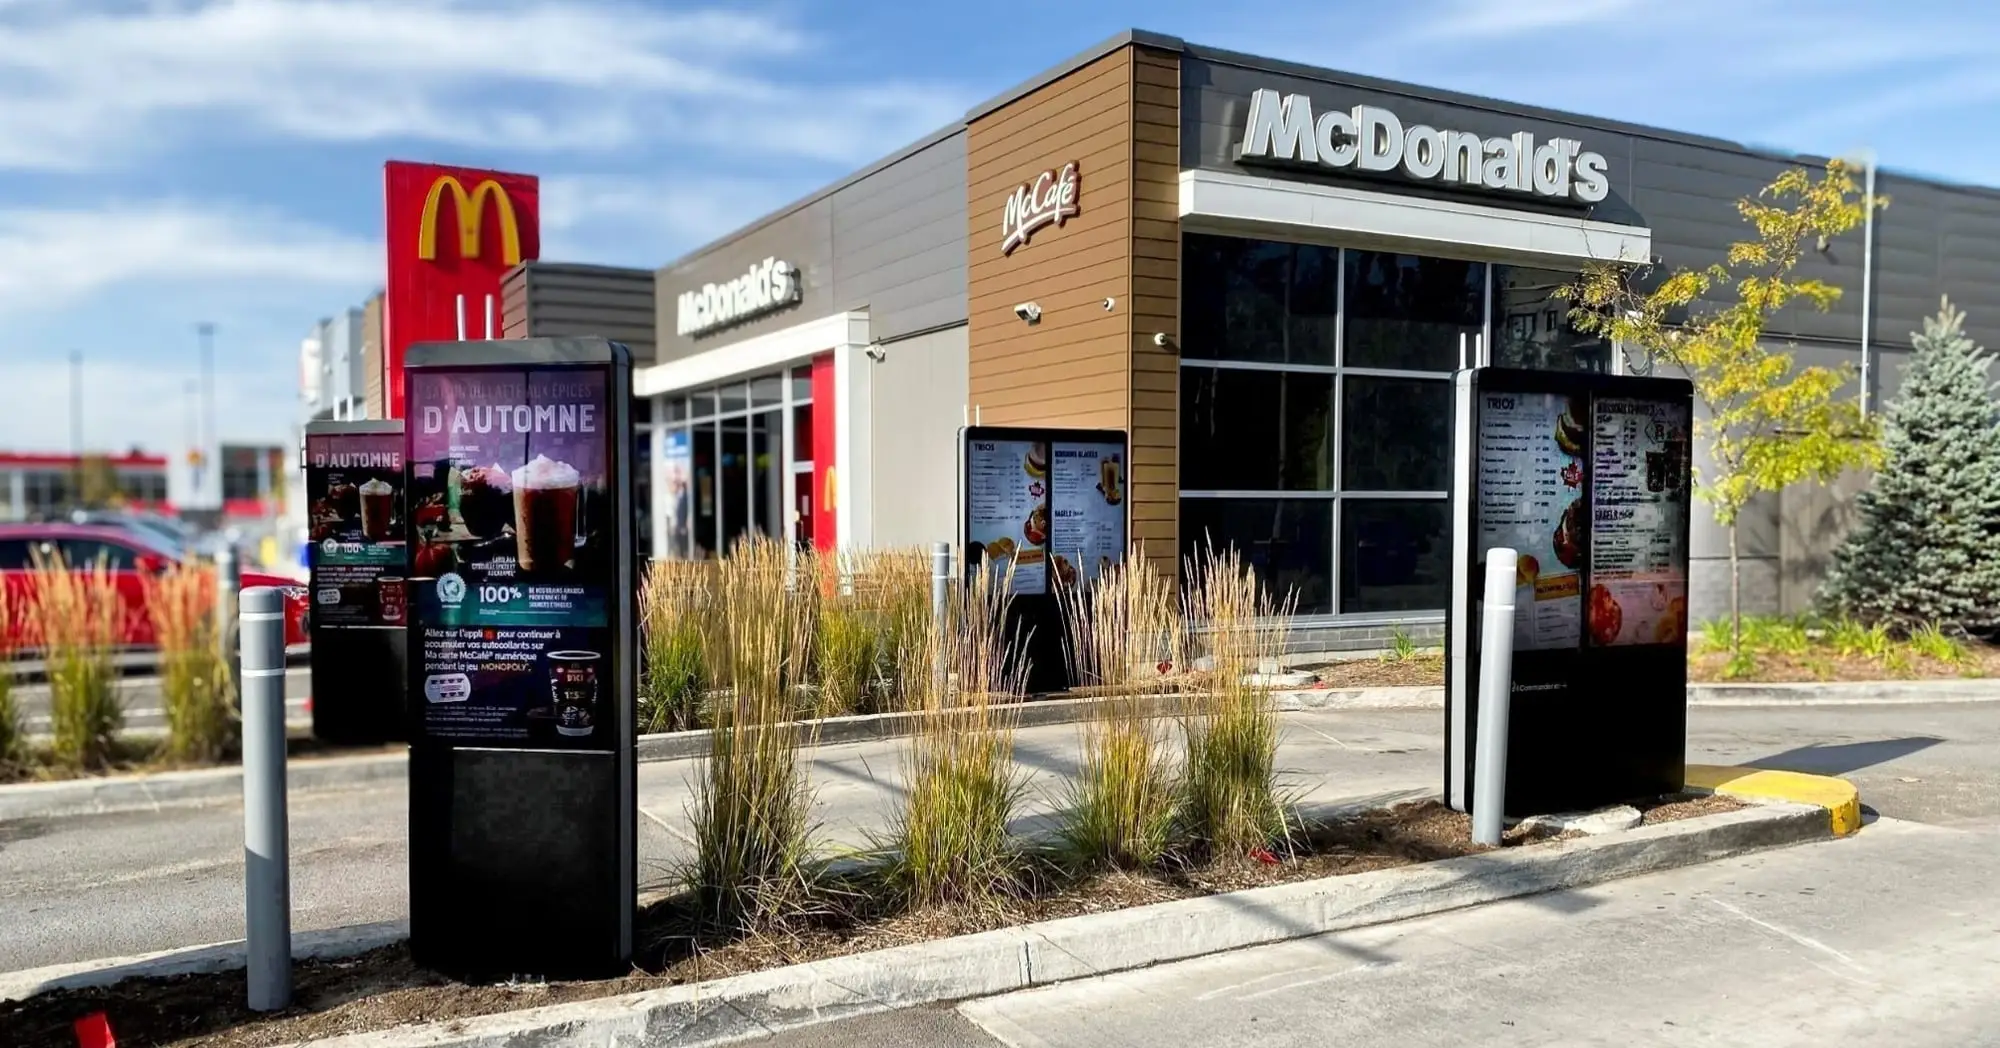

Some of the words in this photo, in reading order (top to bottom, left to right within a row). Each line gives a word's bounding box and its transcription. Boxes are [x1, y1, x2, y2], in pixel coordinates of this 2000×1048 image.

[1240, 88, 1609, 202] McDonald's
[1002, 163, 1076, 239] McCafé
[677, 257, 796, 336] McDonald's
[423, 404, 596, 435] D'AUTOMNE
[315, 452, 401, 469] D'AUTOMNE
[479, 586, 522, 603] 100%
[424, 629, 444, 638] Allez
[497, 631, 516, 641] pour
[516, 630, 554, 639] continuer
[466, 641, 480, 649] vos
[494, 651, 537, 662] numérique
